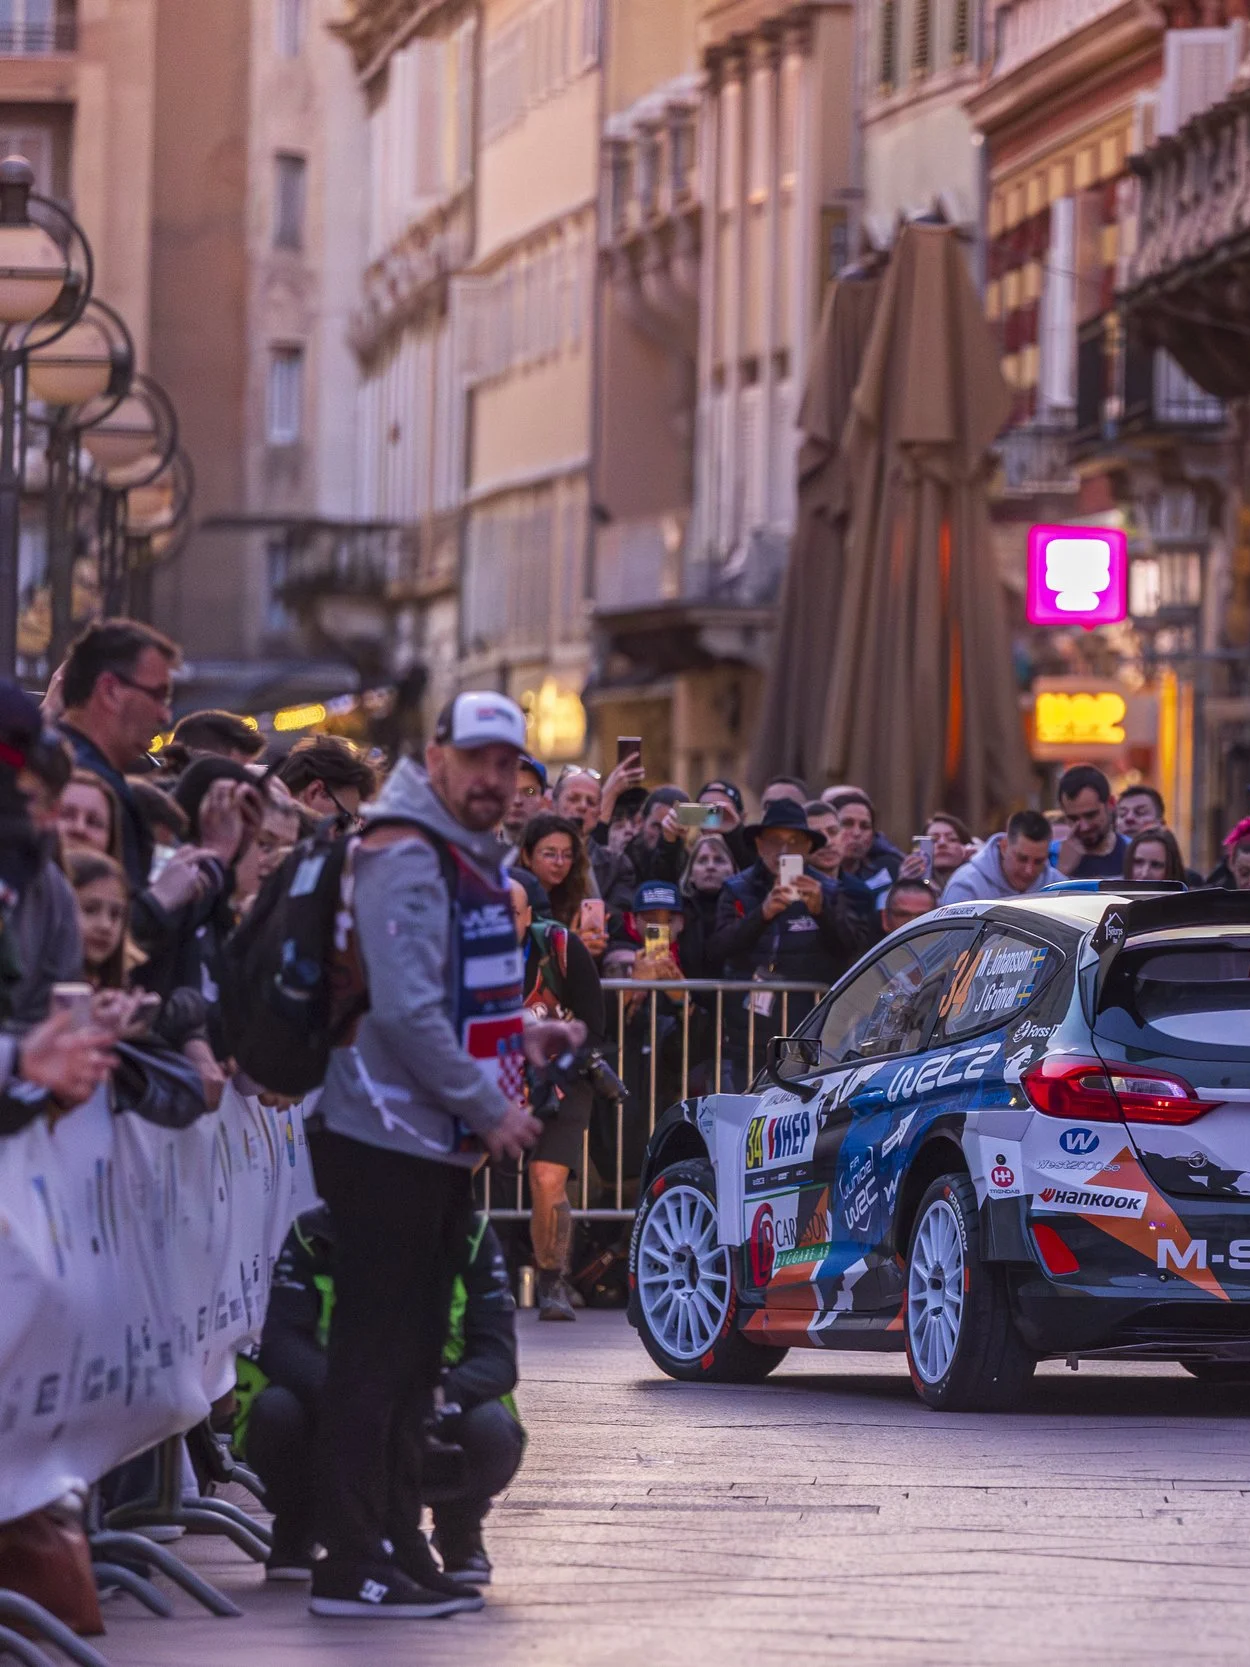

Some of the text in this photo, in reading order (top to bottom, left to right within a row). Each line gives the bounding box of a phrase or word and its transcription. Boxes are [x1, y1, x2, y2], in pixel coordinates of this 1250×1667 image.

[939, 949, 985, 1018] 34
[986, 947, 1034, 977] Johansson
[746, 1111, 810, 1168] 34 HEP
